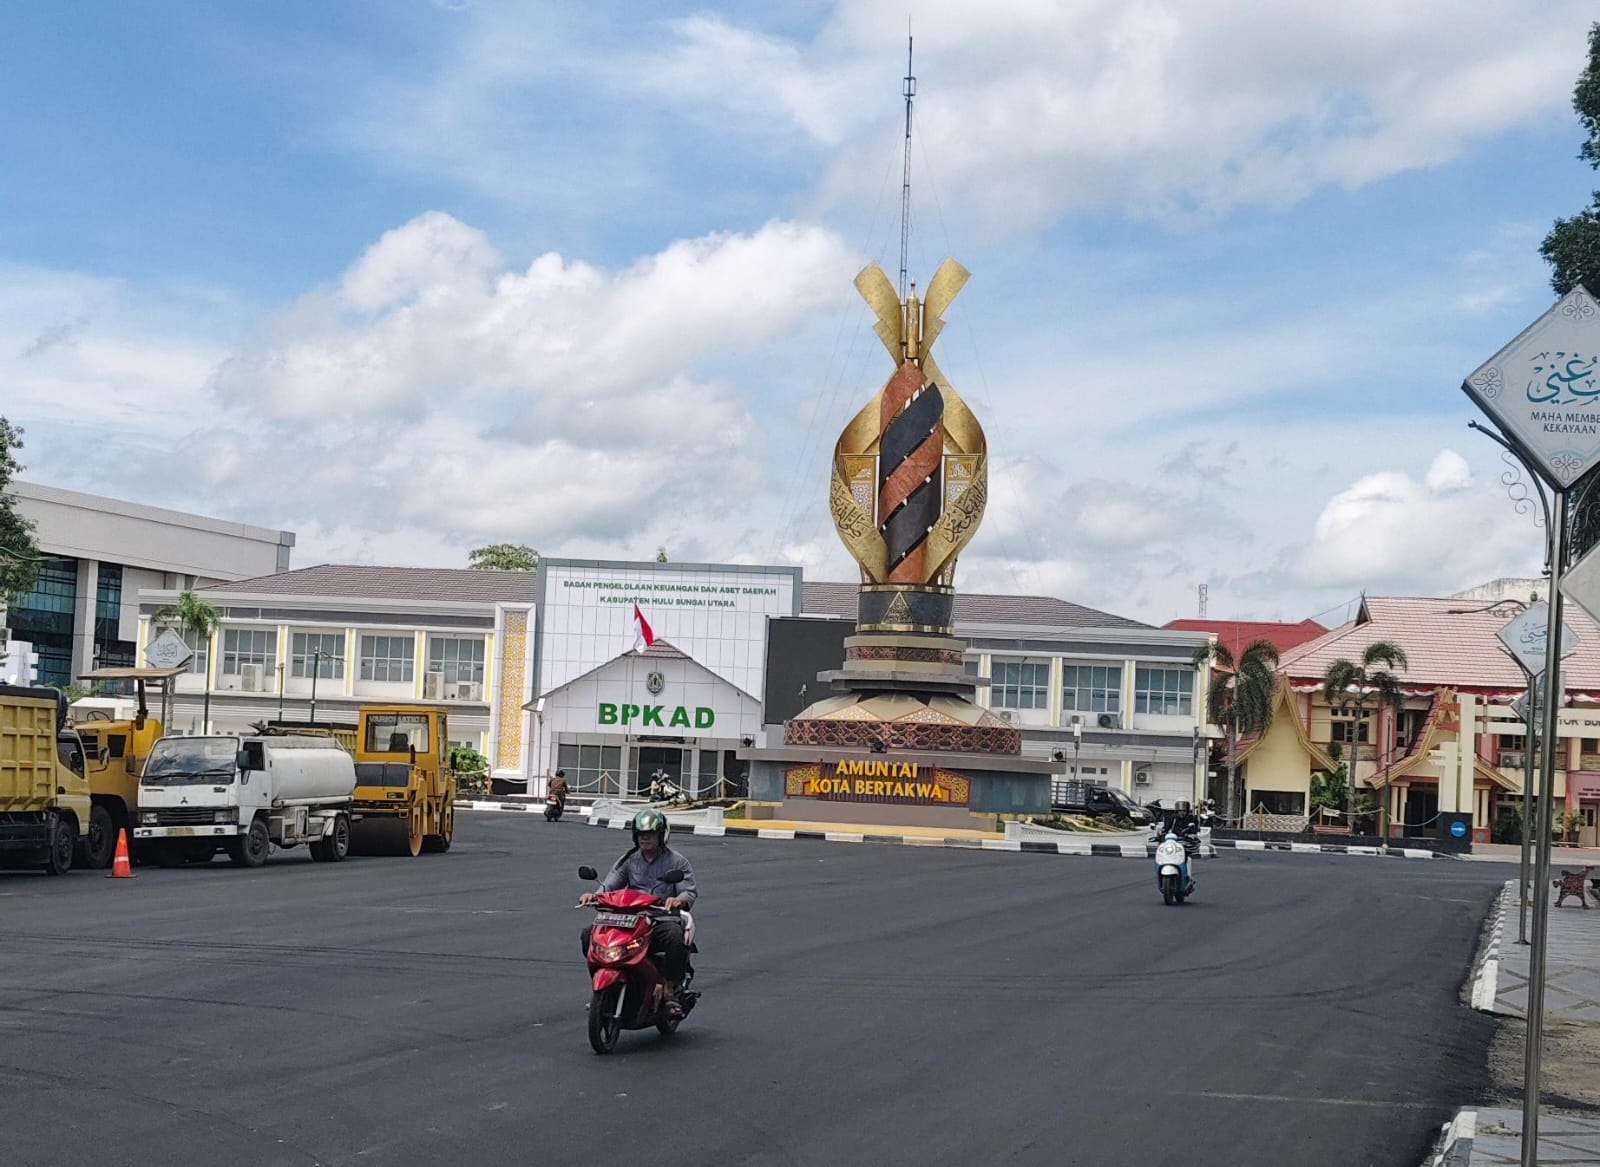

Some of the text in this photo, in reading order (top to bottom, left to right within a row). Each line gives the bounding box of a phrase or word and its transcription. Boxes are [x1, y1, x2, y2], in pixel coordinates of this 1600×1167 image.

[1530, 411, 1600, 423] MAHA MEMBE
[1543, 423, 1597, 434] KEKAYAAN
[563, 580, 592, 589] BADAN
[593, 582, 653, 591] PENGELOLAAN
[654, 584, 699, 593] KEUANGAN
[701, 585, 717, 593] DAN
[742, 587, 777, 595] DAERAH
[600, 596, 736, 608] KABUPATEN HULU SUNGAI UTARA
[598, 702, 715, 729] BPKAD
[836, 759, 918, 778] AMUNTAI
[810, 779, 942, 798] KOTA BERTAKWA
